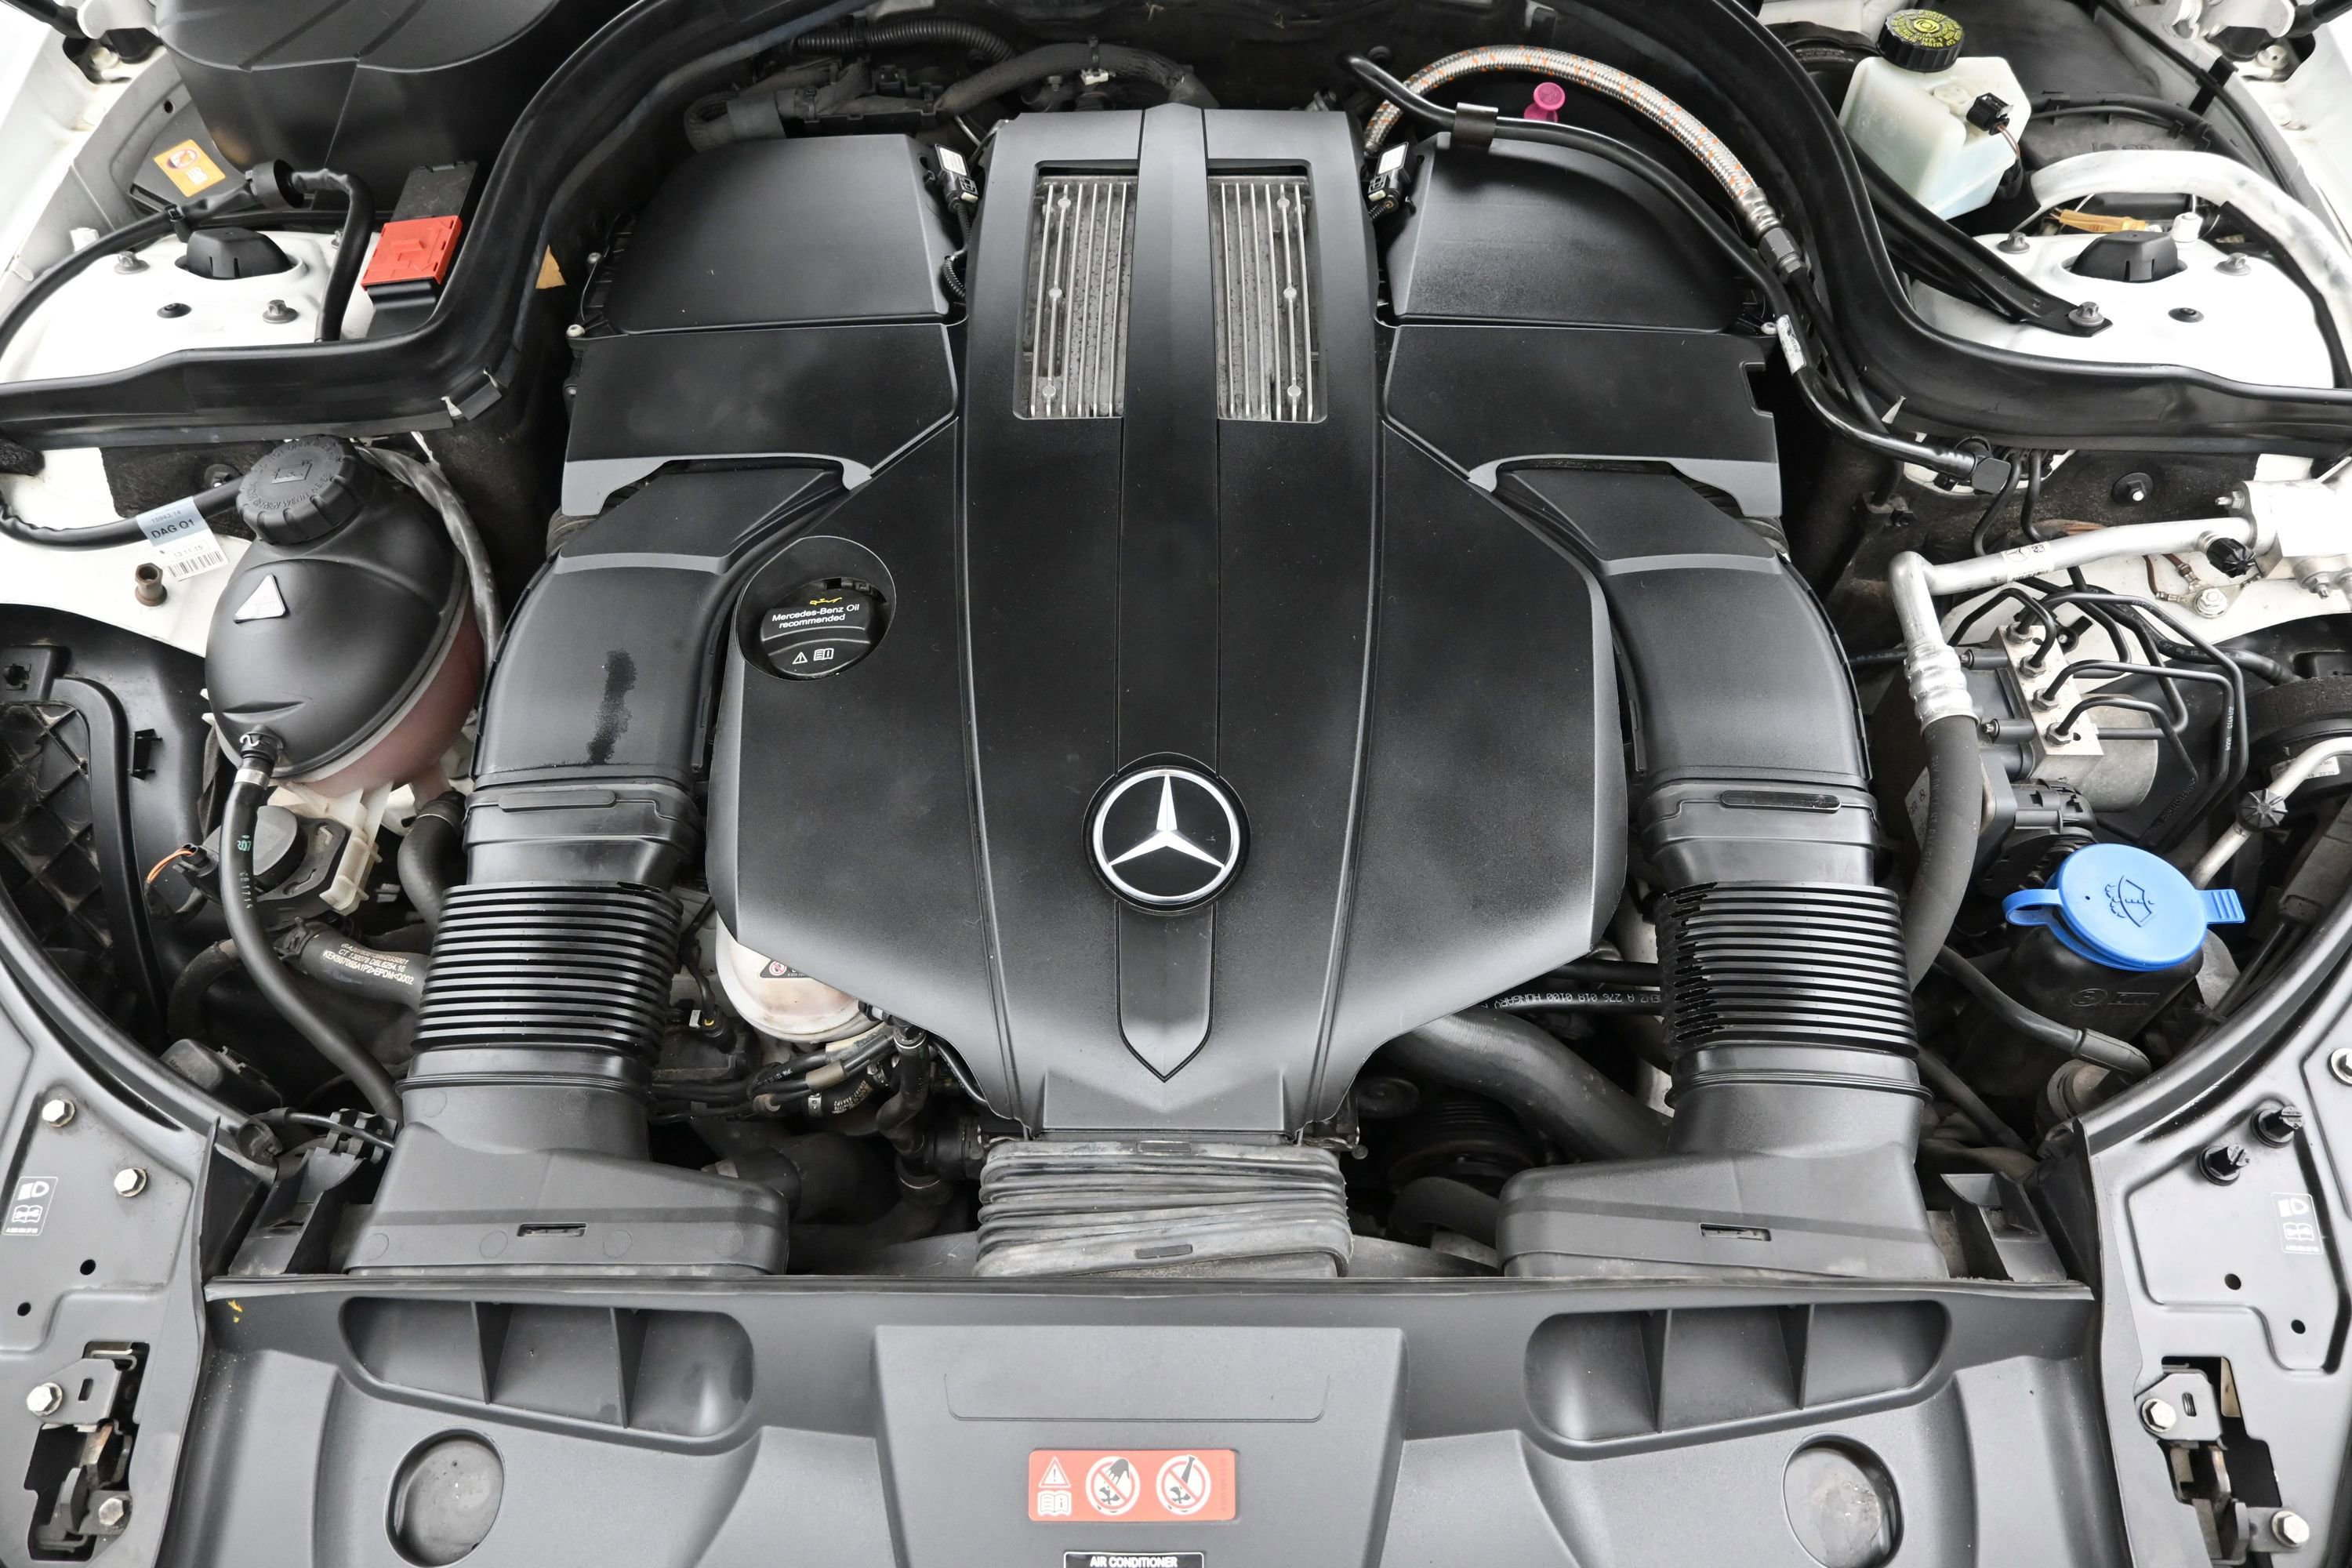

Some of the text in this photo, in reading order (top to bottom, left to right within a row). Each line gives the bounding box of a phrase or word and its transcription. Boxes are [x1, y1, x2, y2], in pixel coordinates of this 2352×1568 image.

[151, 518, 195, 539] DAG Q1
[771, 604, 860, 622] Mercedes-Benz Oil
[779, 614, 846, 629] recommended
[1494, 993, 1541, 1010] HUNGARY
[1546, 992, 1573, 1003] 0100
[1602, 993, 1623, 1003] 276
[1627, 993, 1635, 1003] A
[1090, 1556, 1178, 1568] AIR CONDITIONER
